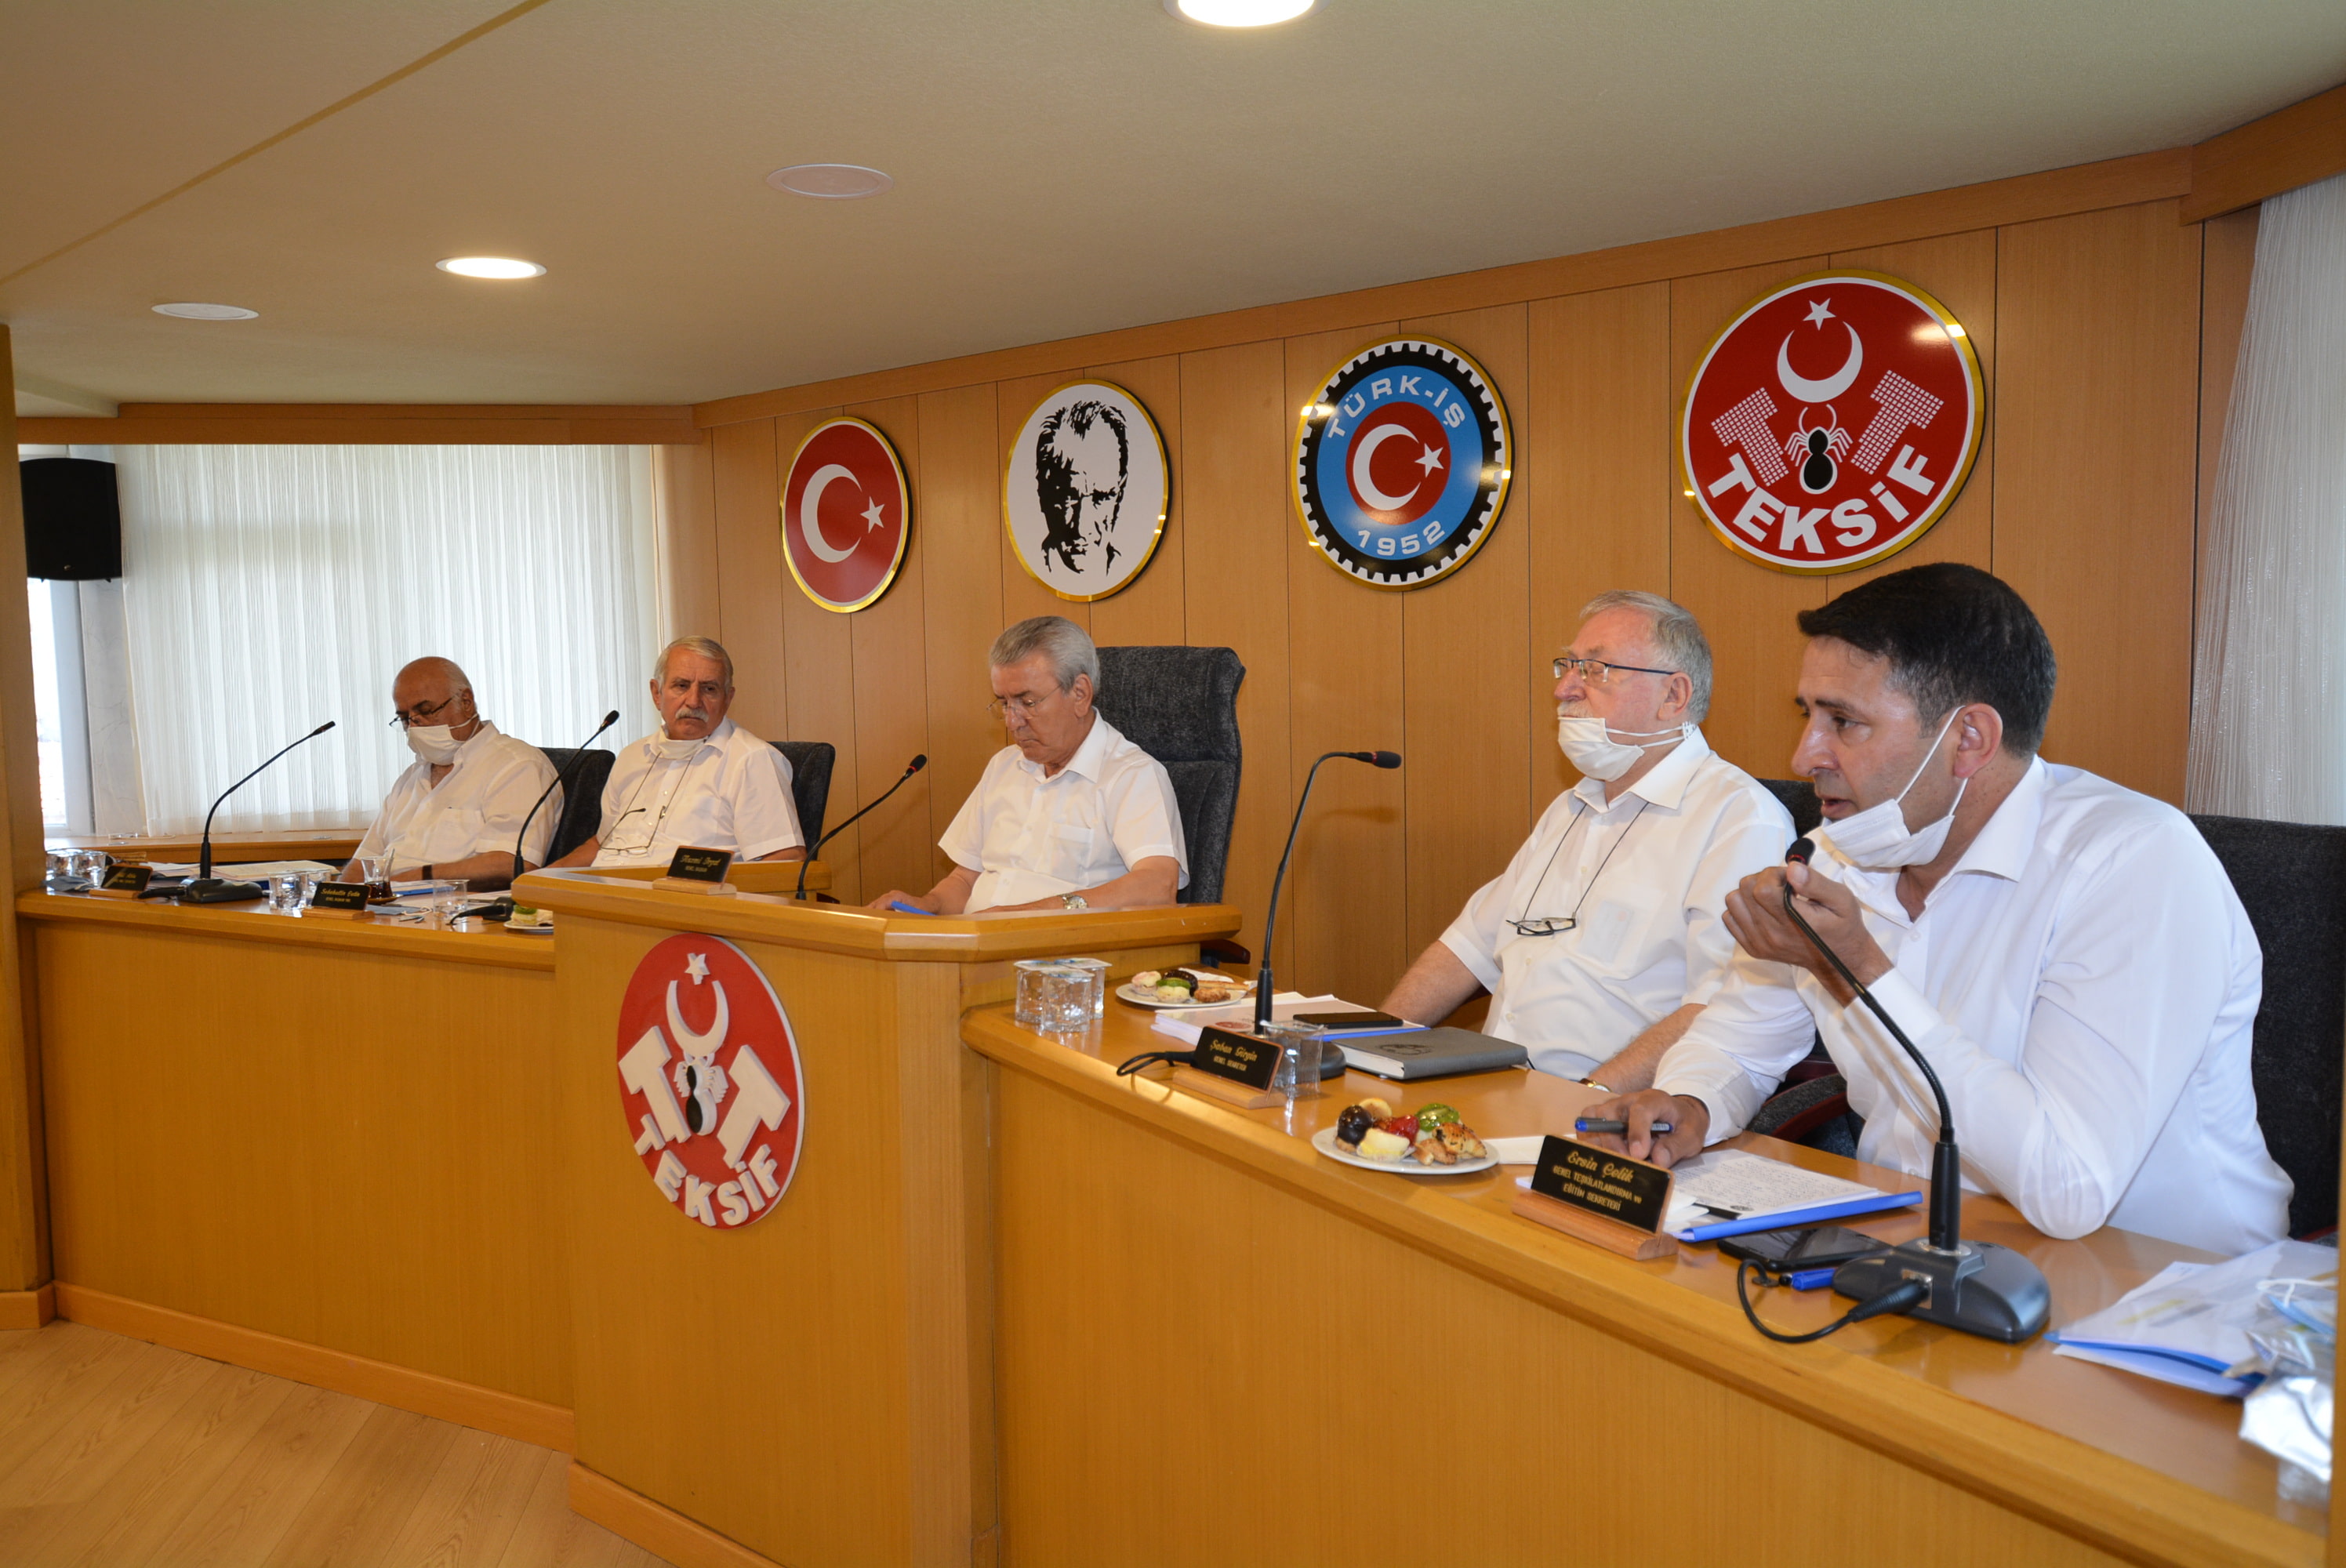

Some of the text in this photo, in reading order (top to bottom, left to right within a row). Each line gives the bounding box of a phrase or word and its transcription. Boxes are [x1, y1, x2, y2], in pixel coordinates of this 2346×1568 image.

[1327, 375, 1465, 439] TÜRK-İŞ
[1357, 521, 1445, 556] 1952
[1552, 1165, 1572, 1179] GENEL
[1567, 1151, 1633, 1182] Ersin Çelik
